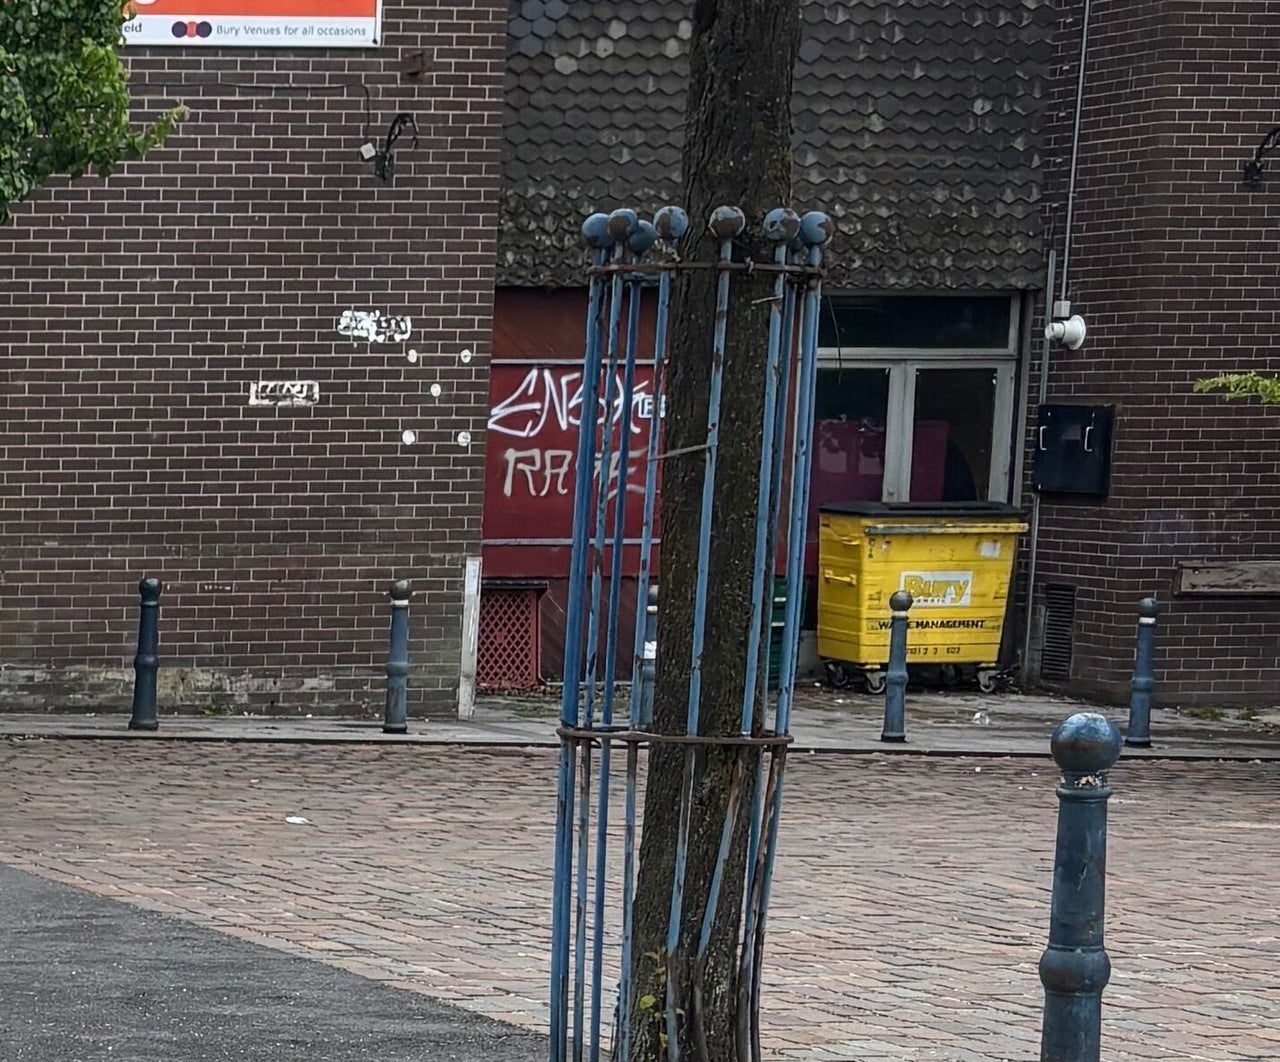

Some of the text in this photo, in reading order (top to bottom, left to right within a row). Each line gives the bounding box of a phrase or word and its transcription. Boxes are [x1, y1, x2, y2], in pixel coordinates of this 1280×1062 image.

[216, 24, 366, 38] Bury Venues for all occasions
[915, 619, 986, 630] MANAGEMENT
